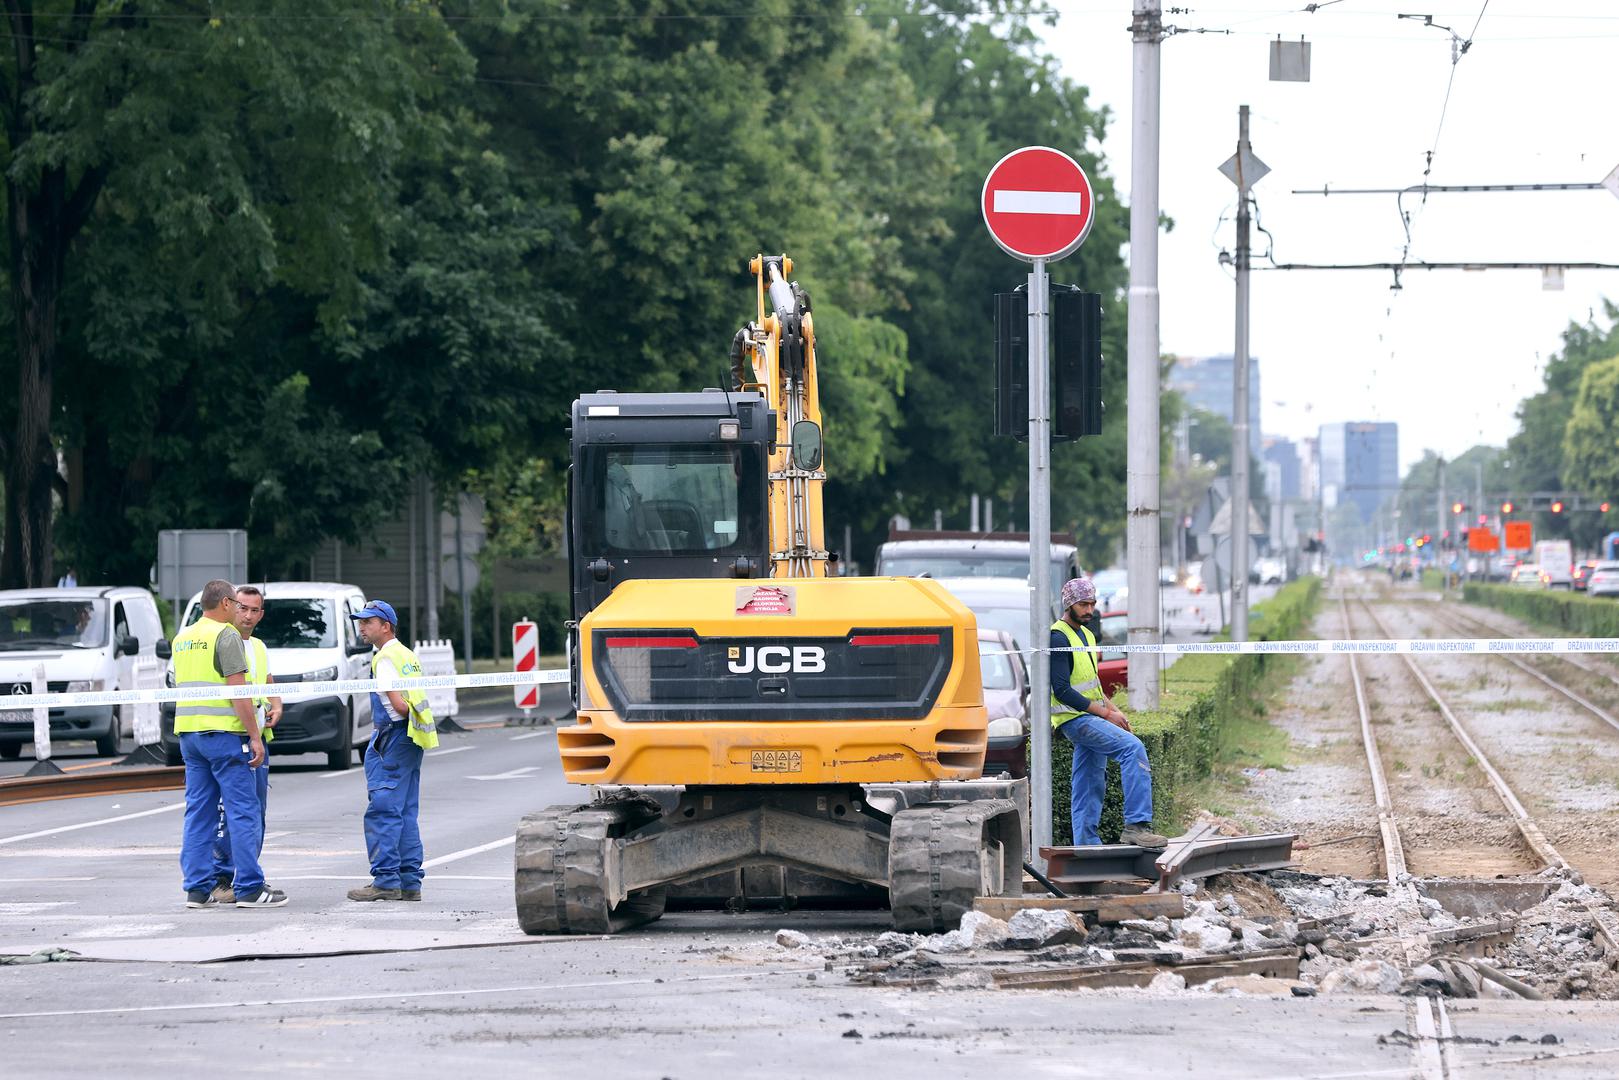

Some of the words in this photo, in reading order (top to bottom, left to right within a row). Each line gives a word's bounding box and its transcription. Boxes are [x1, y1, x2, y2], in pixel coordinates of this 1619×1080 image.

[1203, 643, 1241, 652] INSPEKTORAT
[1281, 642, 1319, 652] INSPEKTORAT
[1359, 642, 1397, 651] INSPEKTORAT
[1437, 642, 1475, 651] INSPEKTORAT
[1515, 641, 1554, 651] INSPEKTORAT
[728, 646, 826, 674] JCB
